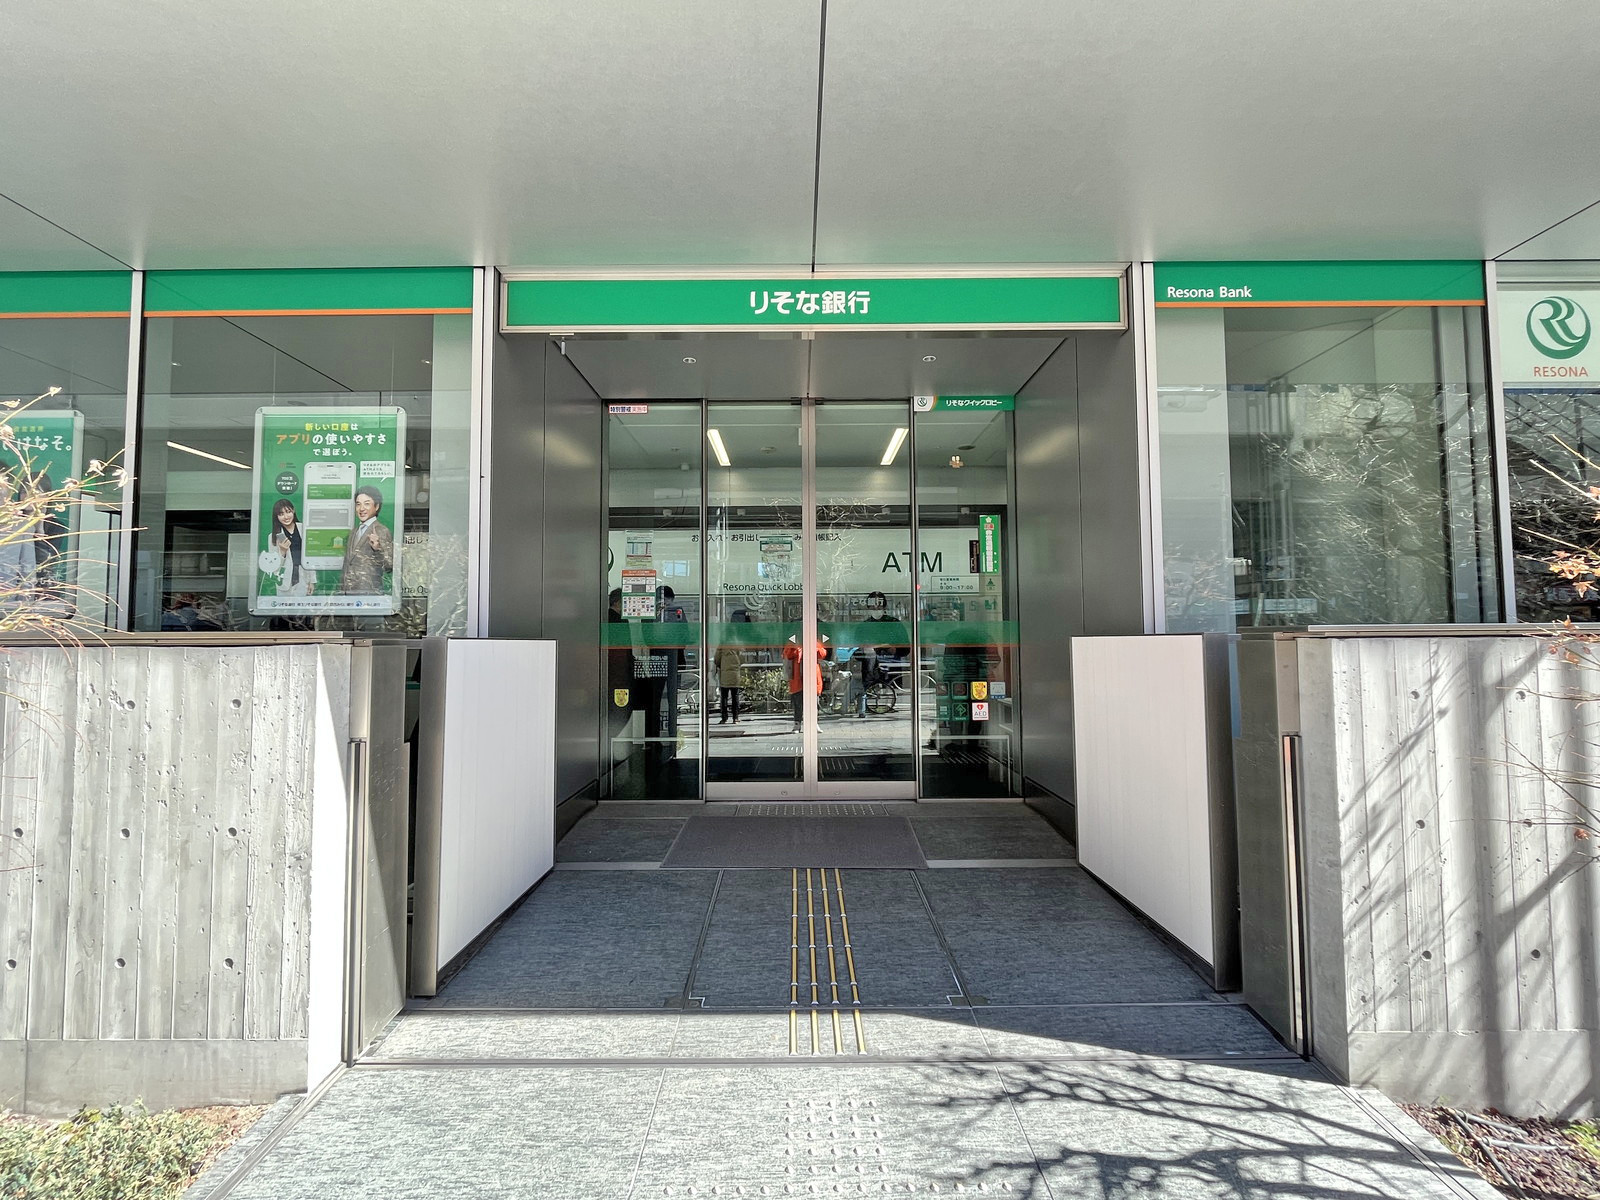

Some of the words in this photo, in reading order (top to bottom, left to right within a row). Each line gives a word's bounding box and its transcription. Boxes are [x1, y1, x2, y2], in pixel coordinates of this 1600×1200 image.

[1167, 286, 1214, 298] Resona
[1219, 285, 1252, 298] Bank
[749, 290, 871, 315] りそな銀行
[1533, 366, 1589, 378] RESONA
[945, 399, 1003, 407] りそなクイックロビー
[304, 423, 359, 431] 新しい口座は
[276, 433, 387, 445] アプリの使いやすさ
[312, 448, 352, 456] で選ぼう。
[723, 583, 756, 591] Resona
